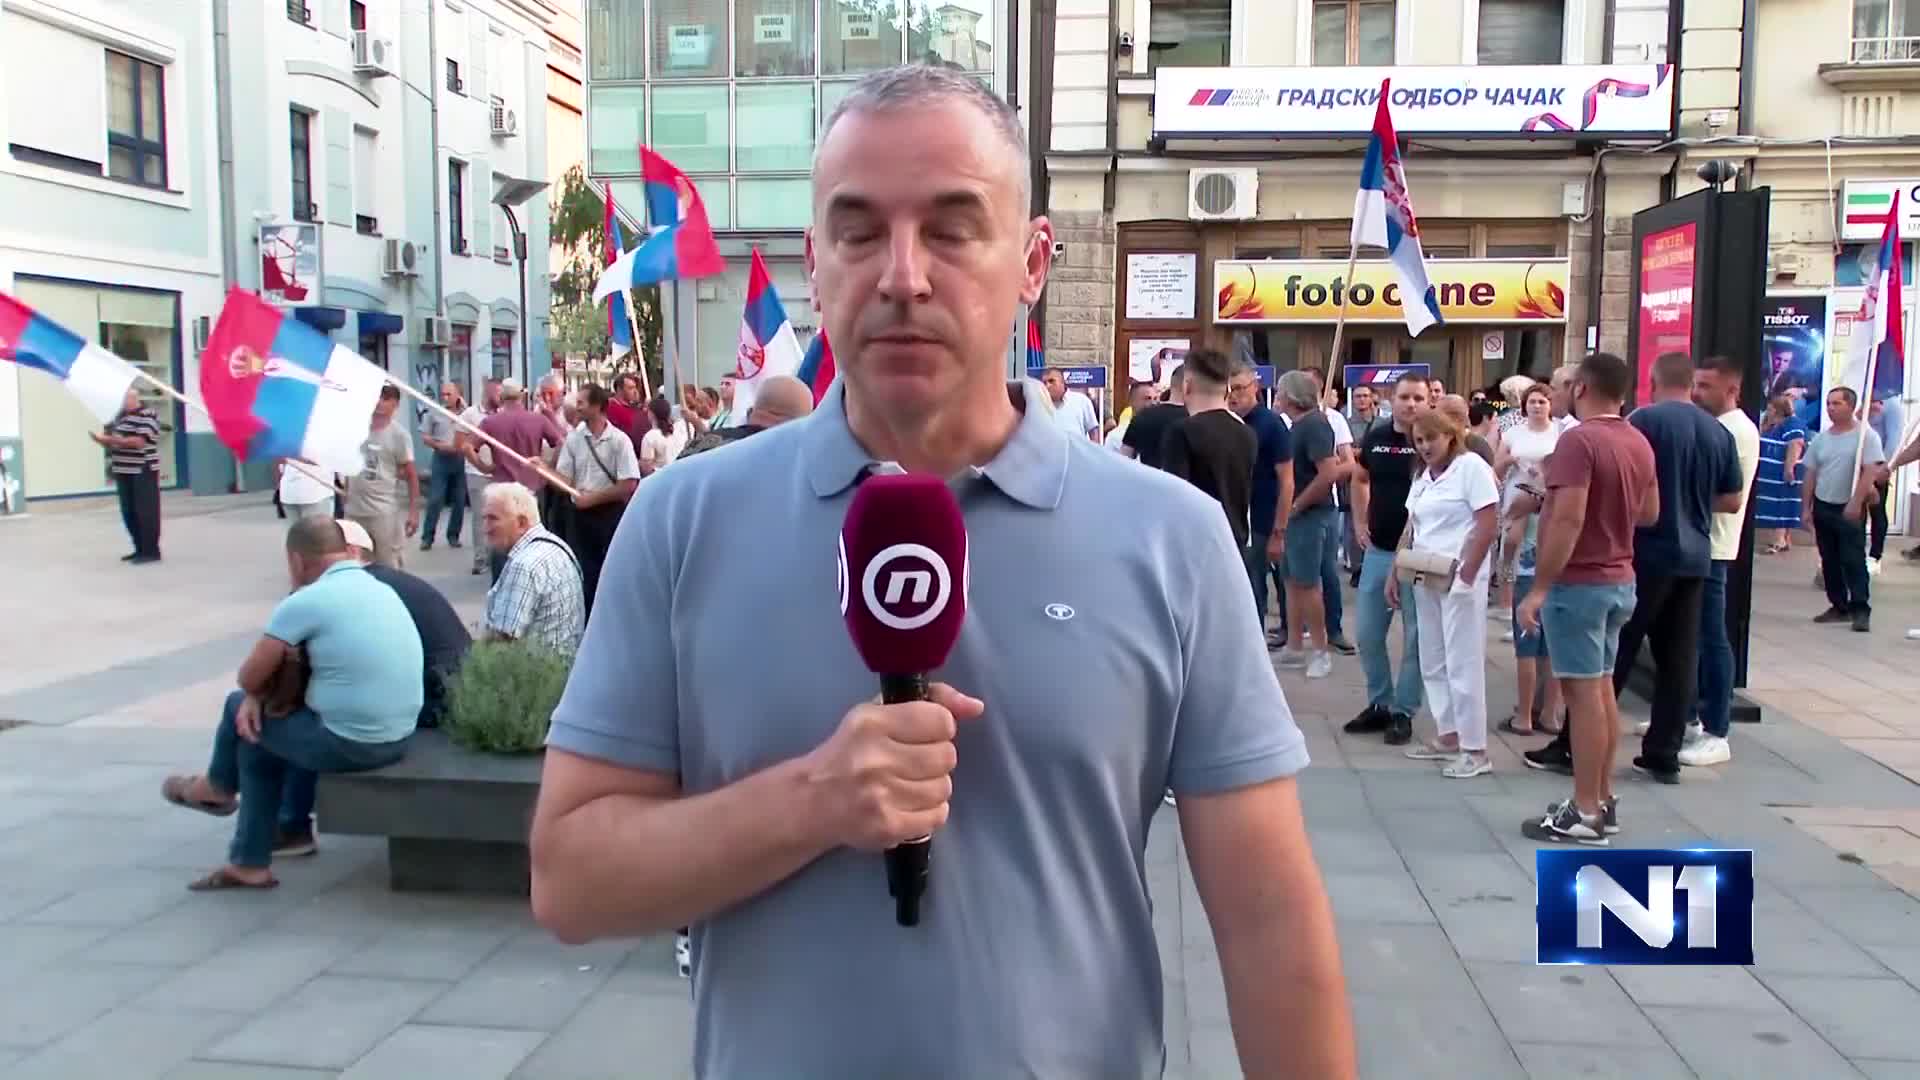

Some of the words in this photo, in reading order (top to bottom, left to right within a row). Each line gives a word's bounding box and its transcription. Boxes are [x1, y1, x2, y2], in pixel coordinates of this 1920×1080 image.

[1277, 88, 1382, 109] ГРАДСКИ
[1392, 88, 1477, 109] ОДБОР
[1485, 88, 1565, 106] ЧАЧАК
[1284, 275, 1375, 306] foto
[1382, 283, 1495, 306] cne
[1764, 315, 1809, 325] TISSOT
[1371, 446, 1391, 454] JACK
